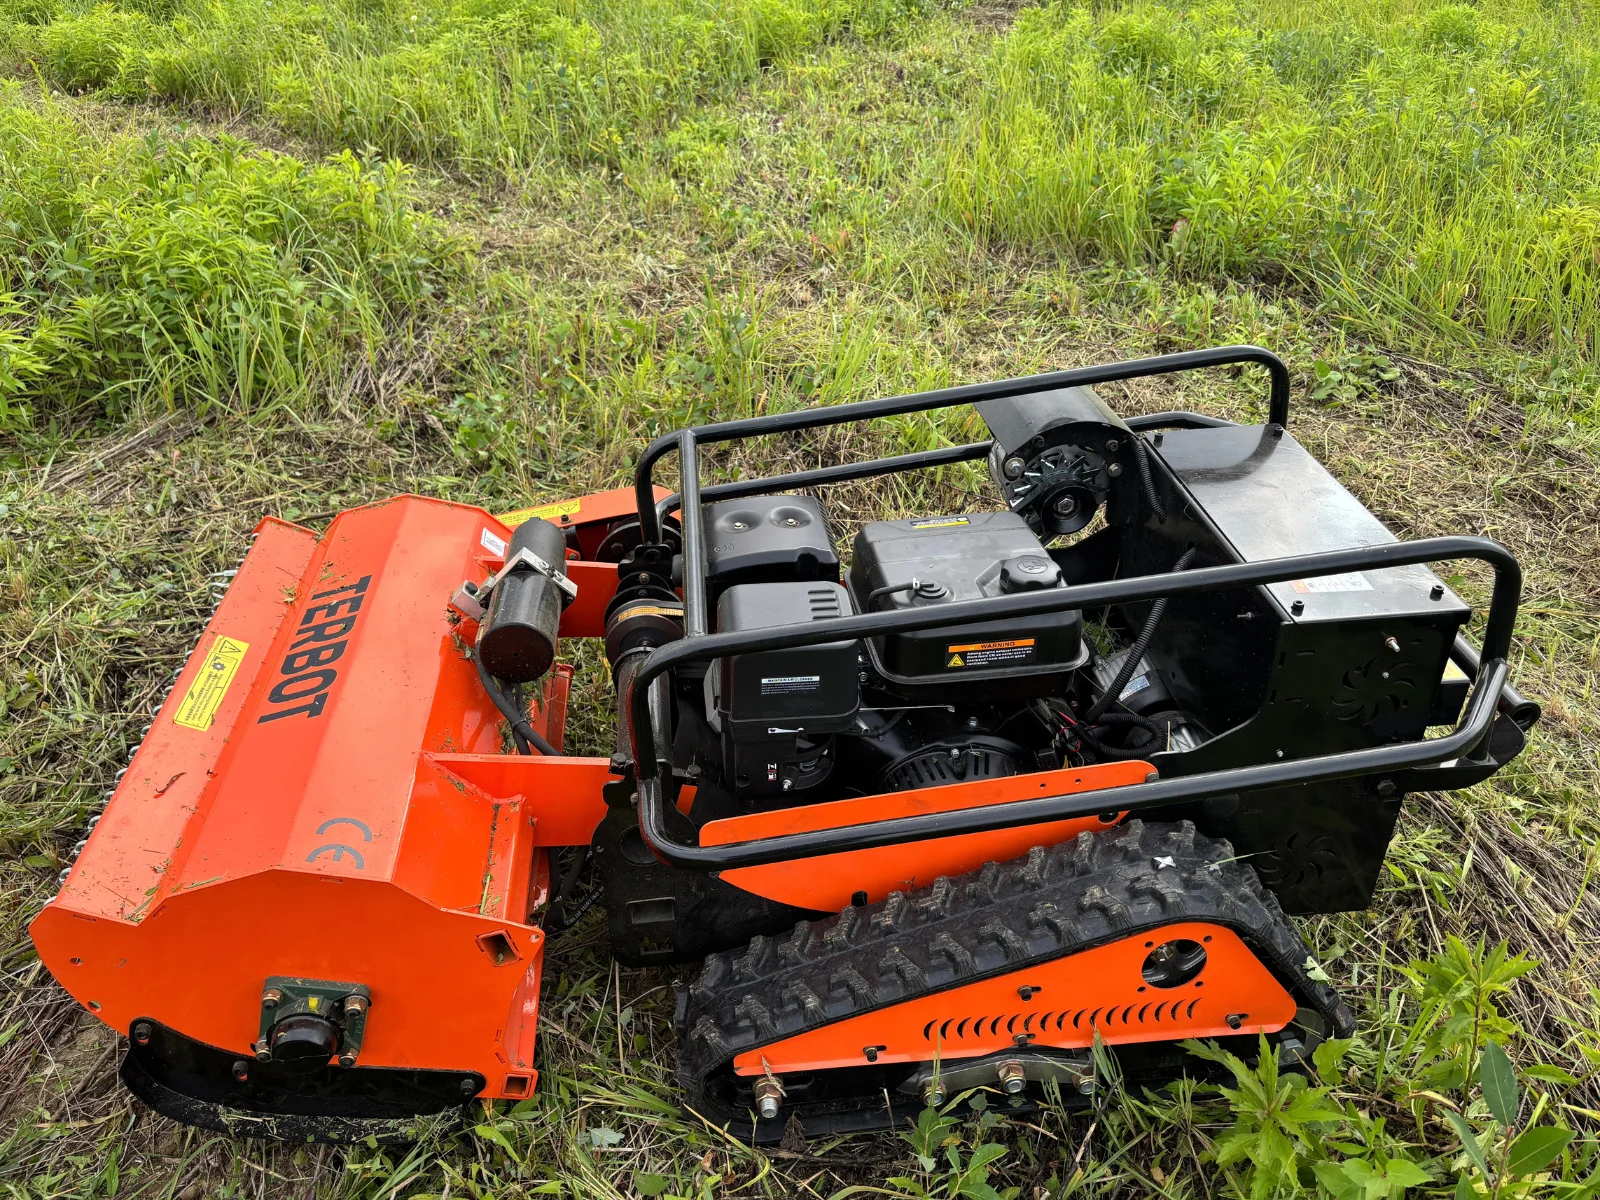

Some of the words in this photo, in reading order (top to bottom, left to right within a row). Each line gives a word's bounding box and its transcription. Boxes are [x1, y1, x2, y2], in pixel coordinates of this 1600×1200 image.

[257, 575, 372, 724] TERBOT
[981, 641, 1015, 649] WARNING
[306, 817, 372, 870] CE
